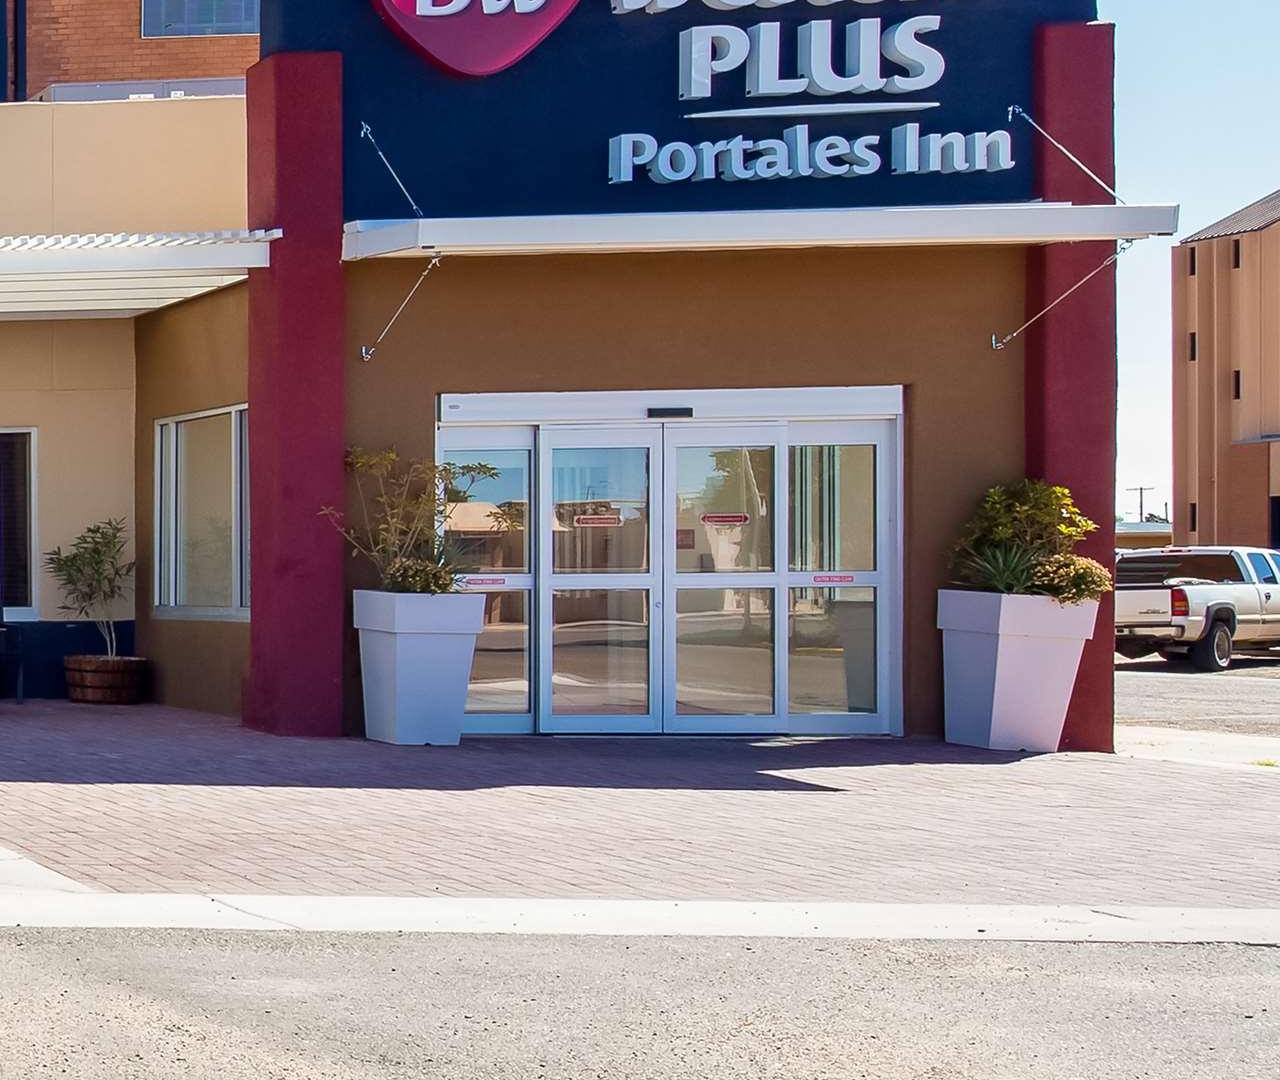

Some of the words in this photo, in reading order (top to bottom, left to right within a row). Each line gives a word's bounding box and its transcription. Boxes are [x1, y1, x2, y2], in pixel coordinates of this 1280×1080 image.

[678, 15, 946, 101] PLUS
[608, 124, 882, 184] Portales
[890, 123, 1016, 174] Inn
